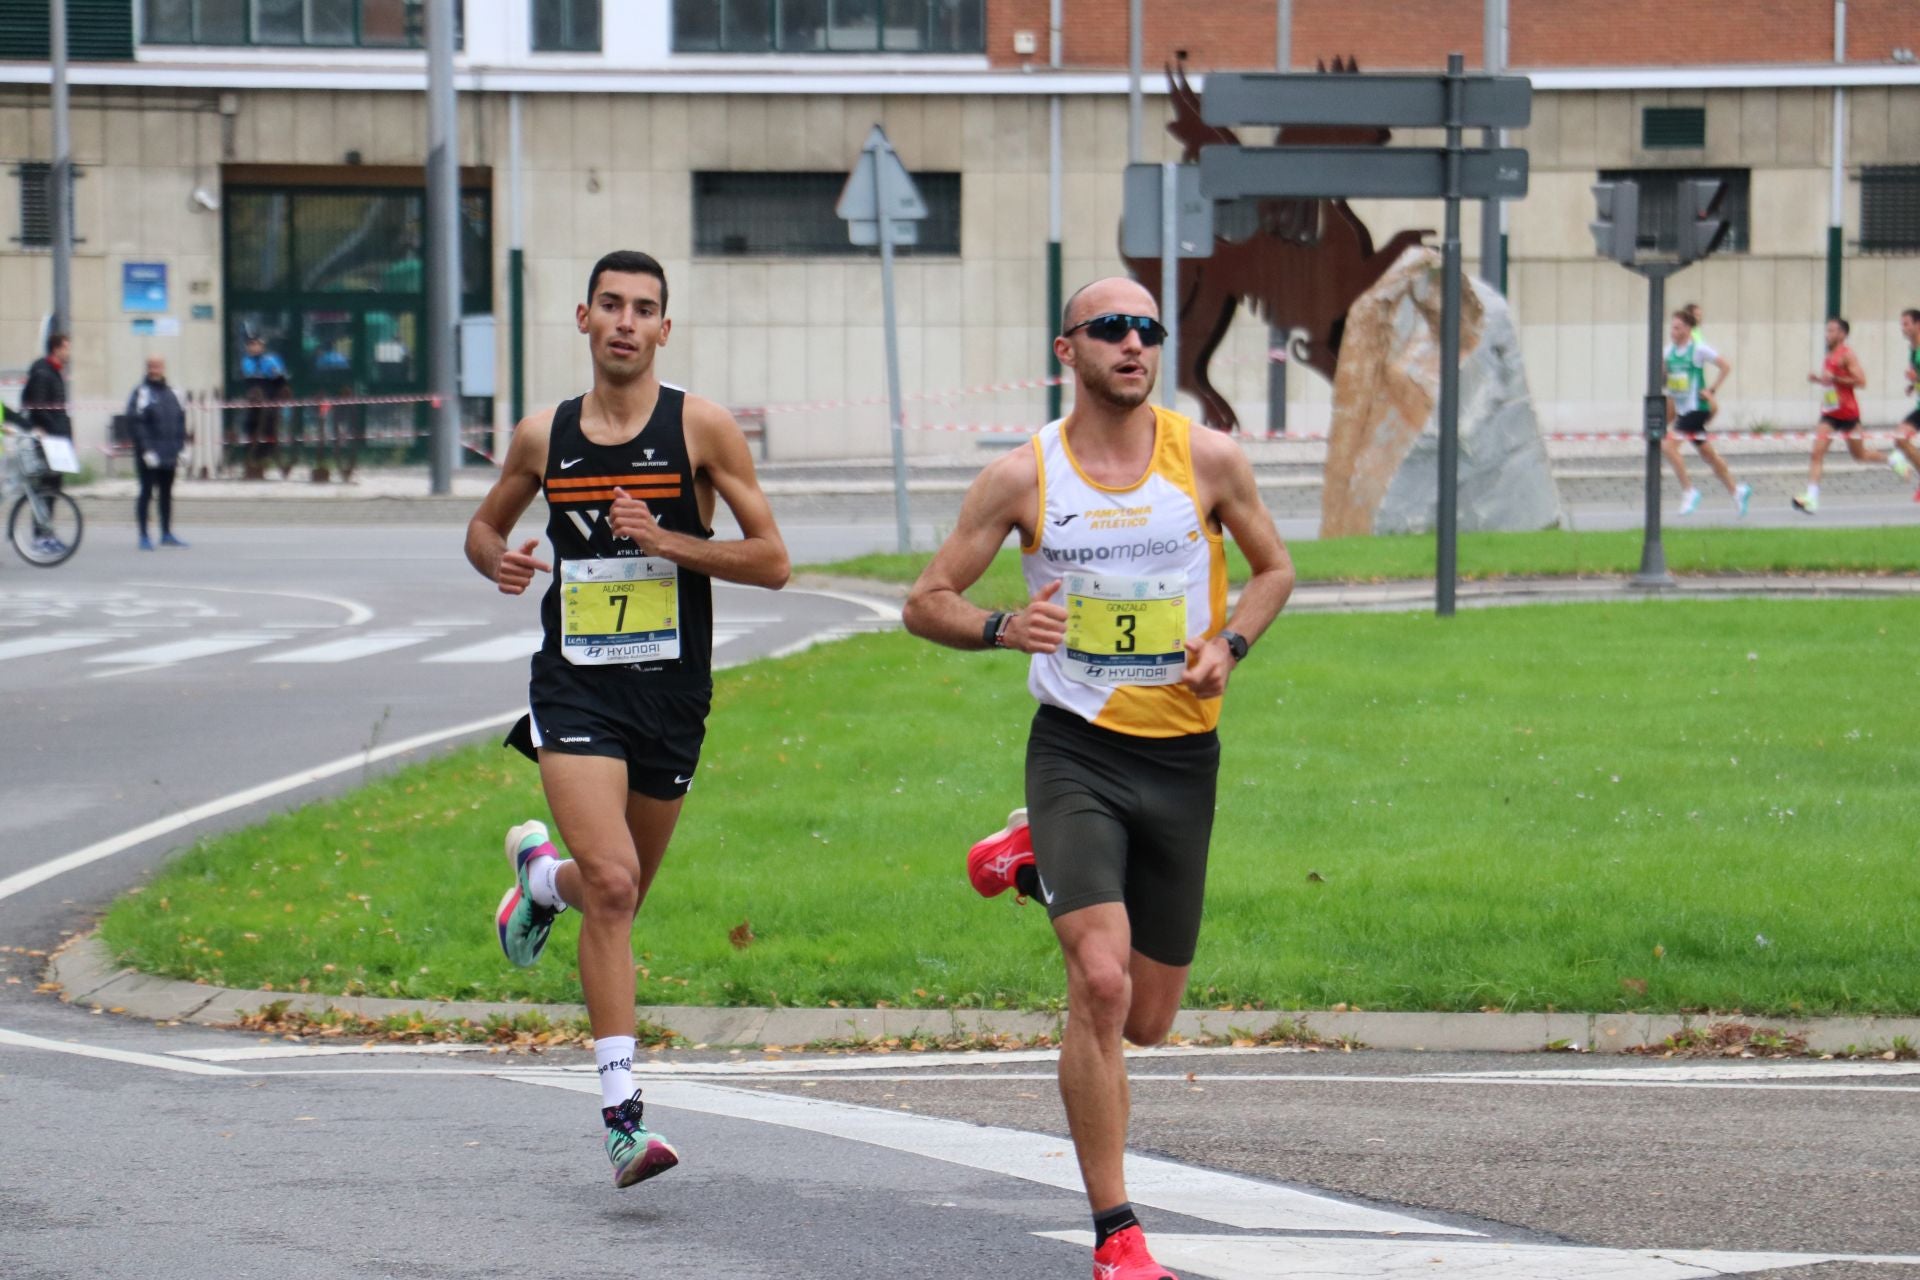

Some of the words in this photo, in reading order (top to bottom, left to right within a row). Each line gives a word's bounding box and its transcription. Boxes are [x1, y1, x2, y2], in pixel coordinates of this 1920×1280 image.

[1084, 505, 1152, 519] PAMPLONA
[603, 584, 634, 593] ALONSO
[609, 595, 628, 632] 7
[1106, 603, 1147, 612] GONZALO
[1115, 615, 1136, 653] 3
[607, 644, 660, 657] HYUNDAI
[1108, 668, 1167, 677] HYUNDAI
